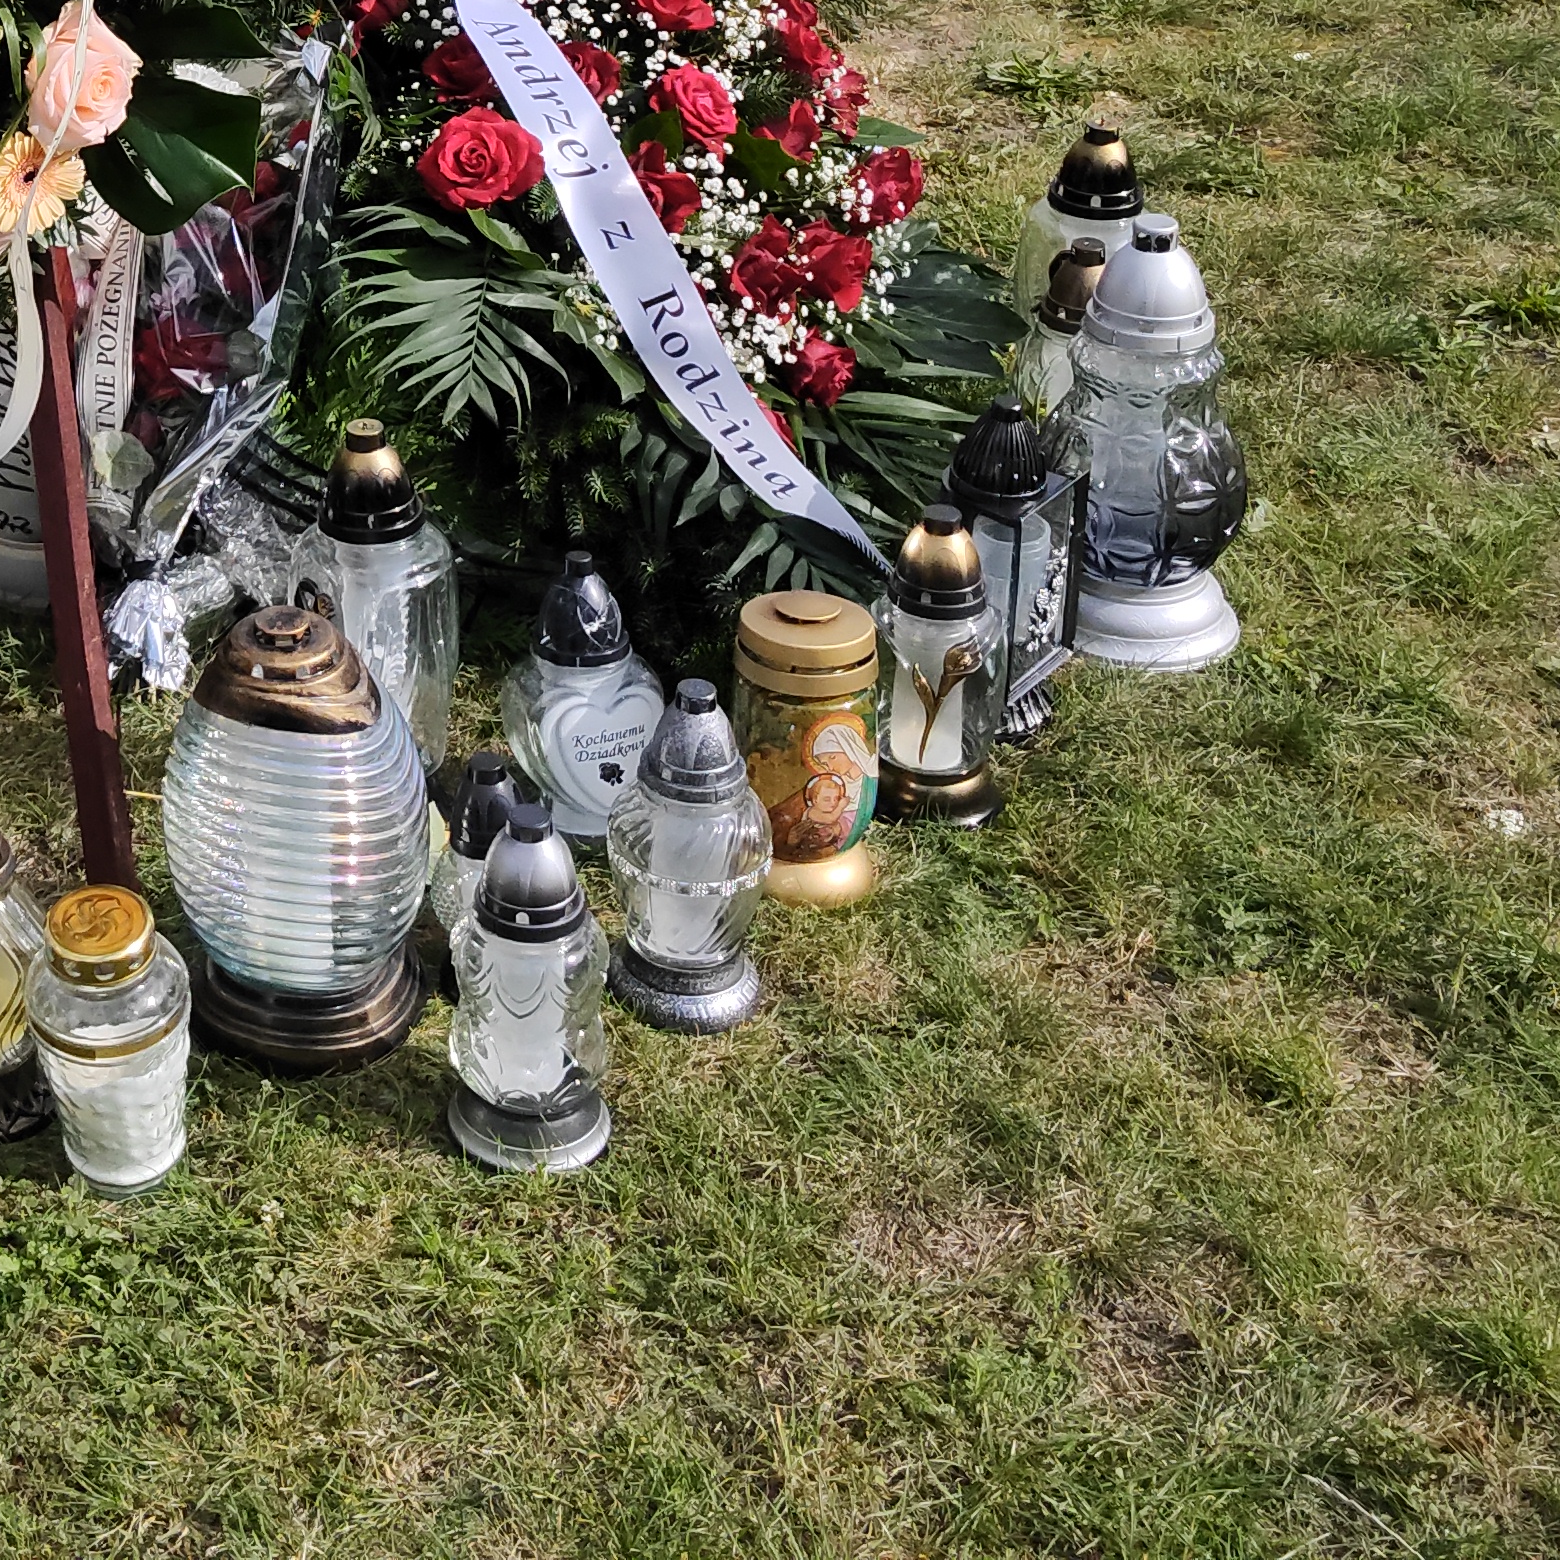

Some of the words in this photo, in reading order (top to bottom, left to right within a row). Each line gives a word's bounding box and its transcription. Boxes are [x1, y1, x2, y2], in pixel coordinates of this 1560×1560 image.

[95, 223, 131, 368] POŻEGNANI
[471, 17, 609, 180] Andrzej
[599, 220, 636, 250] z
[637, 283, 801, 500] Rodziną
[572, 724, 645, 749] Kochanemu
[575, 735, 646, 762] Dziadkowi
